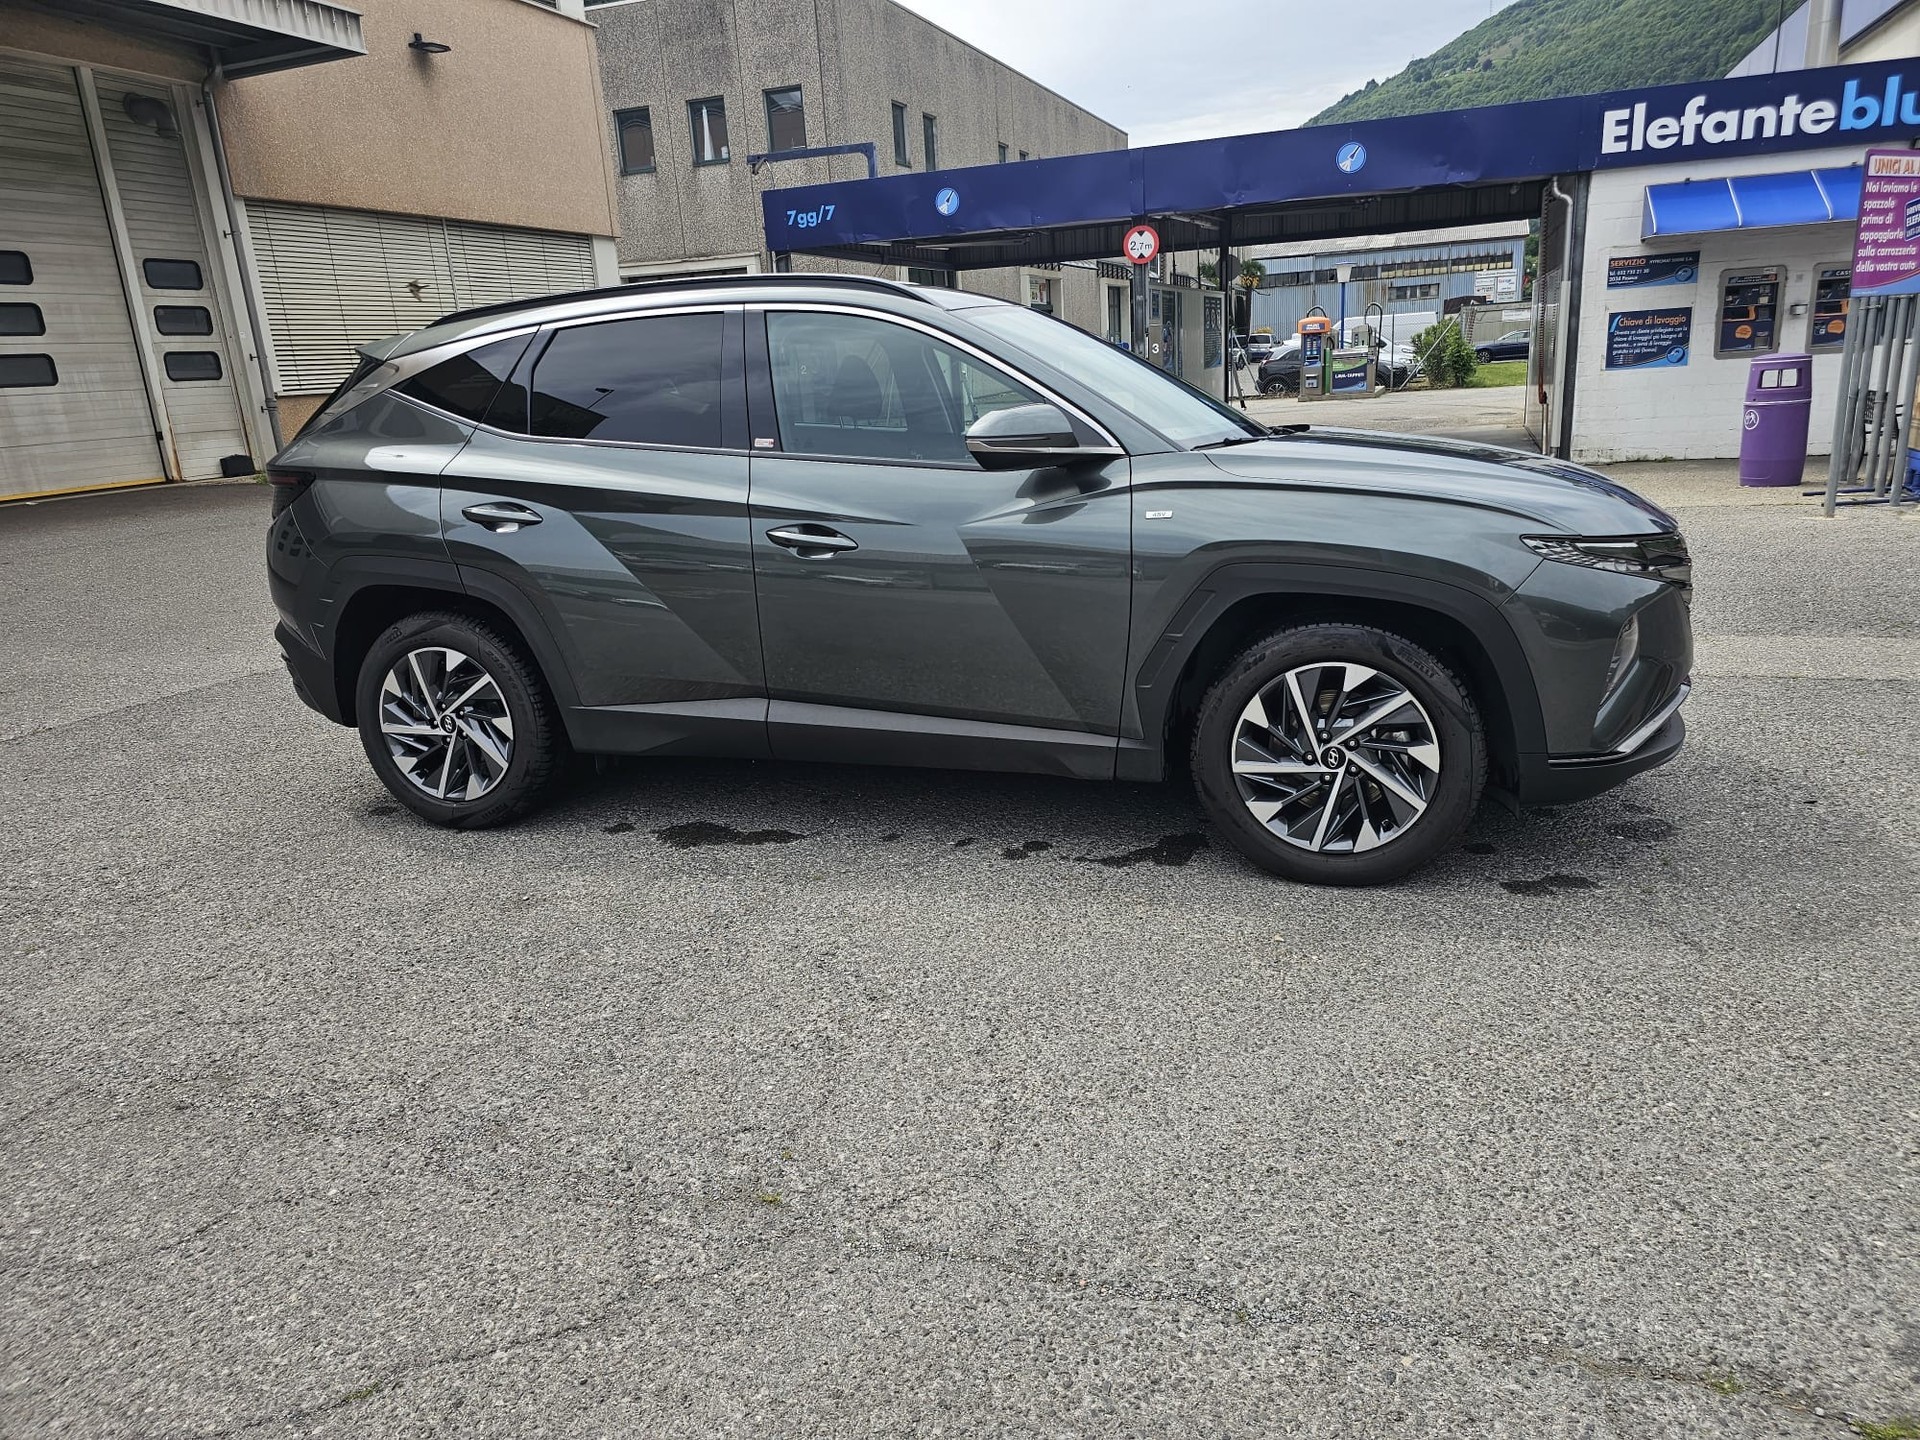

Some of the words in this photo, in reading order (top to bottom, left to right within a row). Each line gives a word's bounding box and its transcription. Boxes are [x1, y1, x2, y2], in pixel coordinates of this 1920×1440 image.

[1874, 158, 1901, 174] UNICI
[1903, 158, 1915, 174] AL
[1865, 181, 1880, 193] Noi
[1880, 181, 1909, 193] laviamo
[1910, 181, 1918, 193] le
[1863, 196, 1895, 212] spazzole
[786, 204, 836, 228] 7gg/7
[1861, 213, 1884, 228] prima
[1884, 212, 1893, 224] di
[1860, 228, 1904, 243] appoggiarle
[1857, 245, 1875, 257] sulla
[1877, 244, 1917, 256] carrozzeria
[1610, 258, 1646, 267] SERVIZIO
[1855, 260, 1874, 272] della
[1876, 261, 1898, 271] vostra
[1899, 260, 1916, 271] auto
[1618, 317, 1643, 327] Chiave
[1645, 315, 1653, 325] di
[1654, 314, 1686, 326] lavaggio
[1152, 343, 1160, 354] 3
